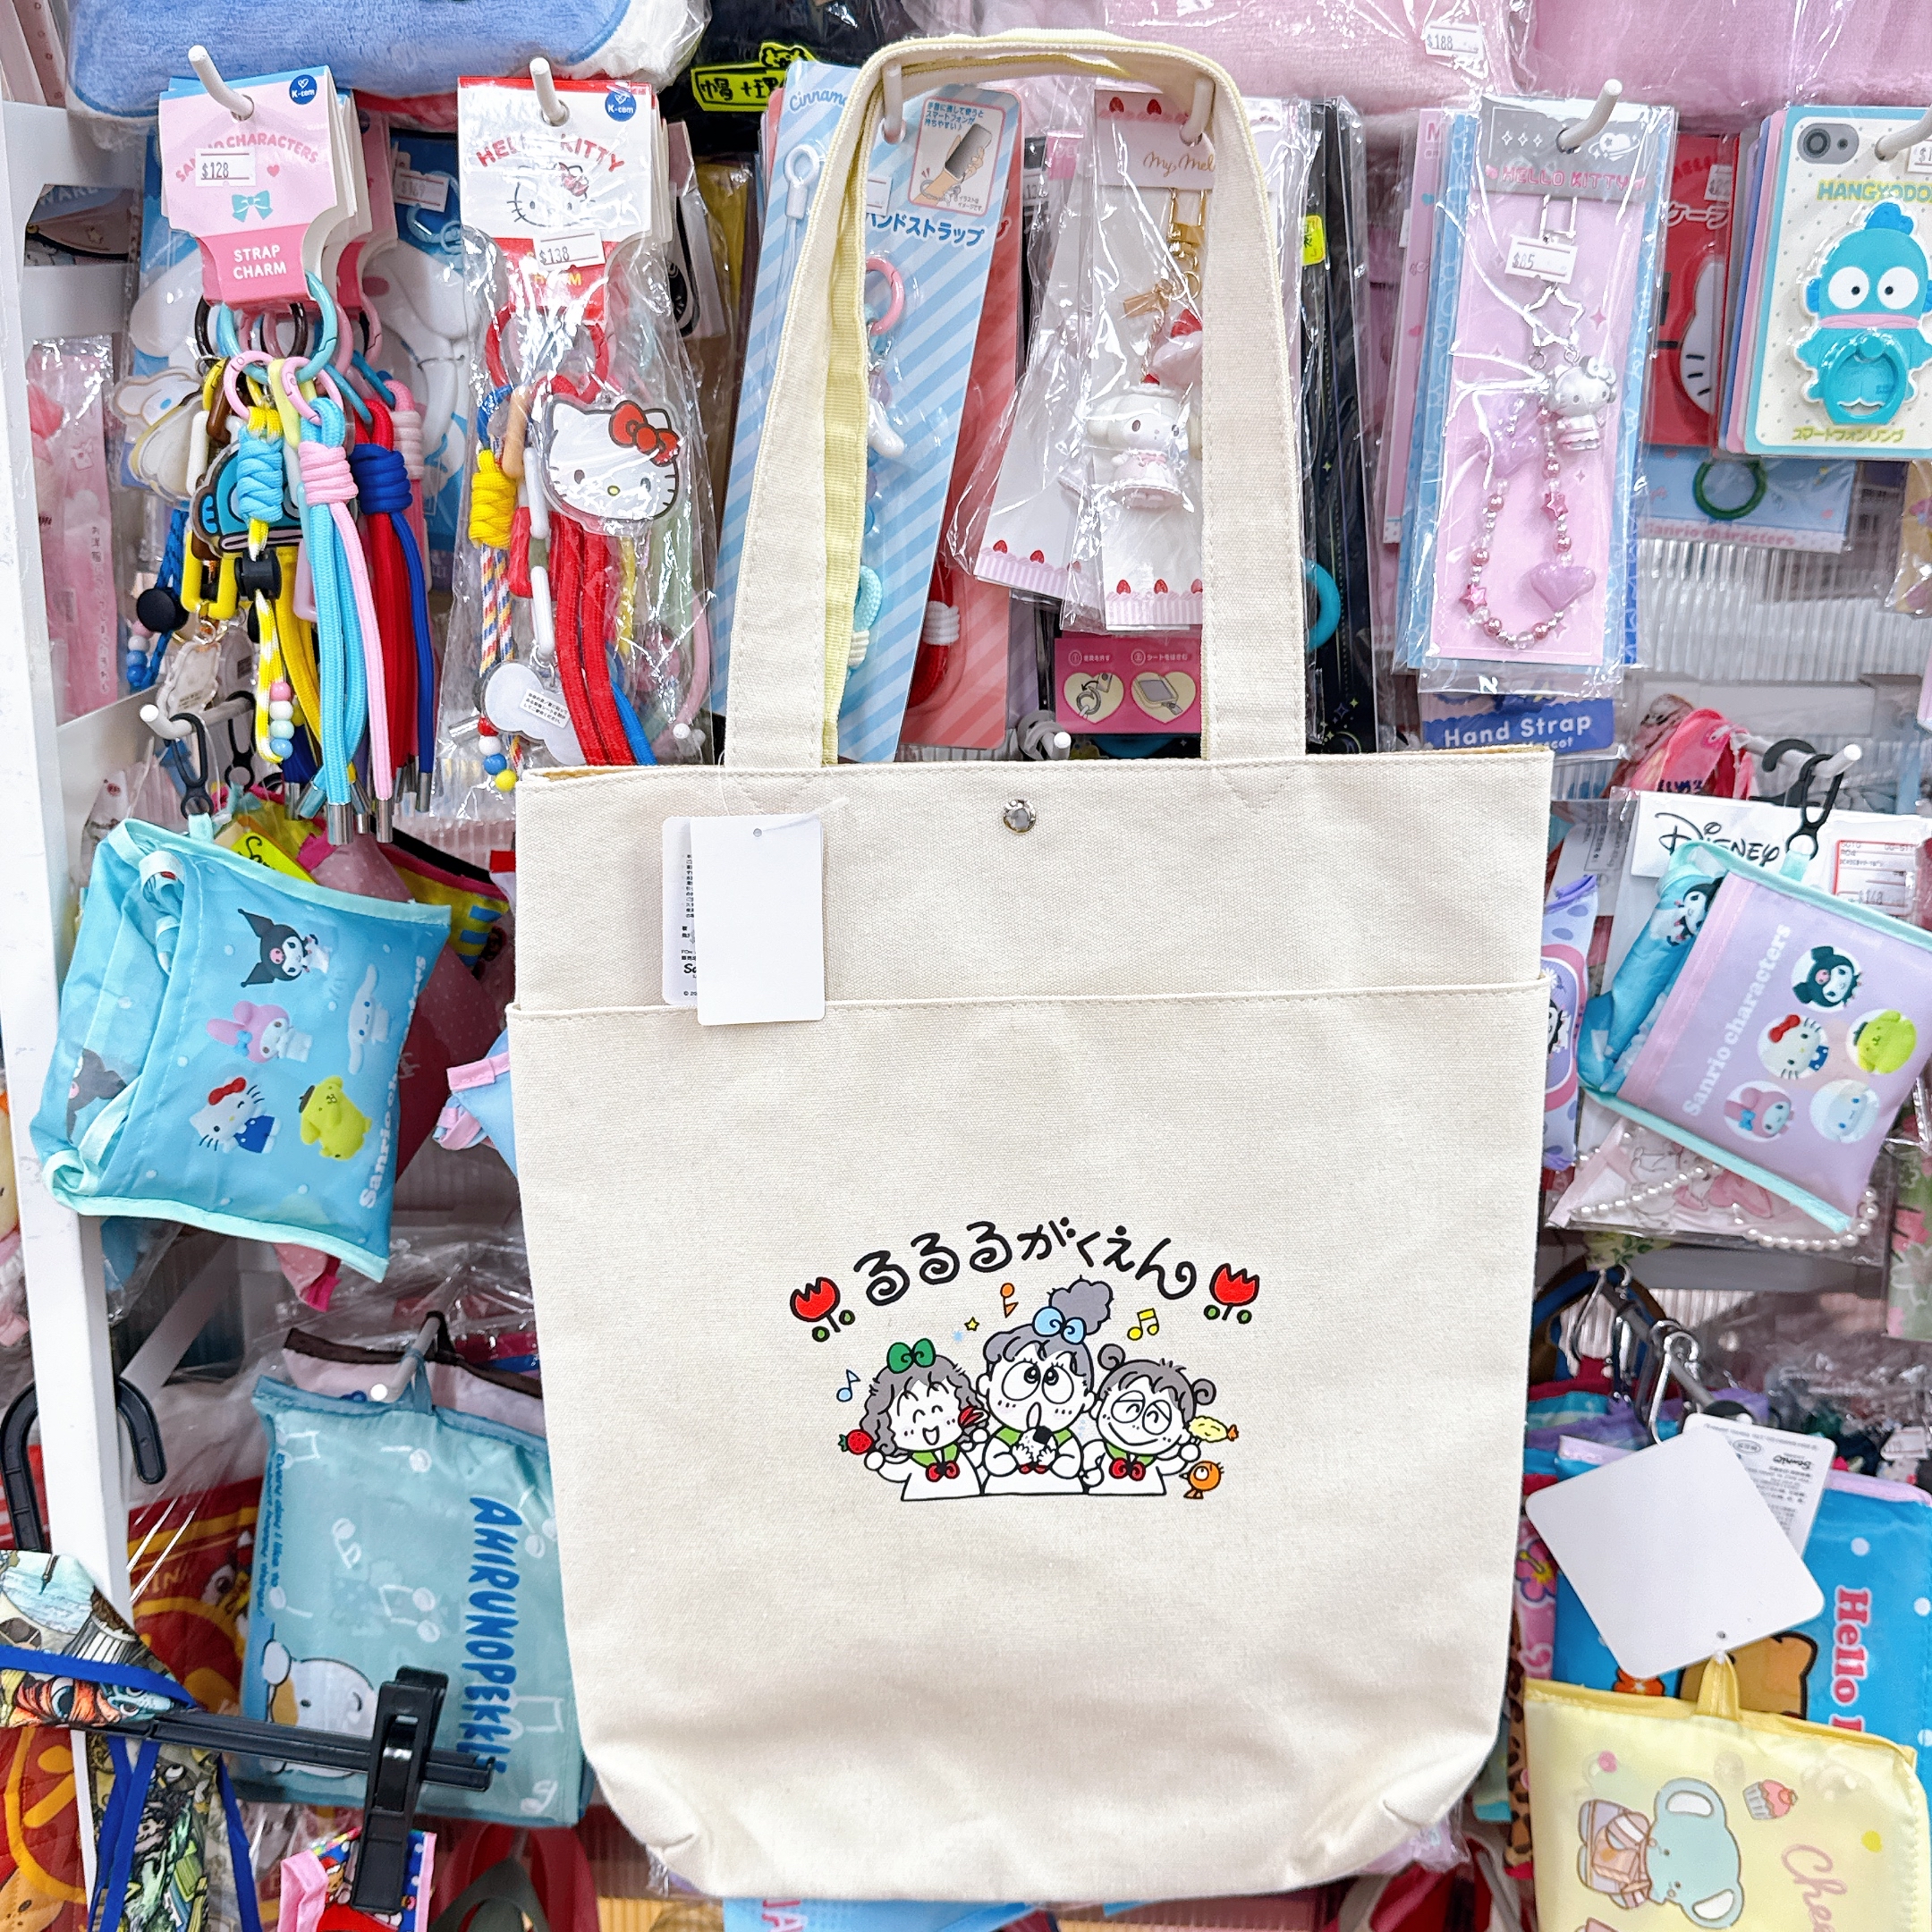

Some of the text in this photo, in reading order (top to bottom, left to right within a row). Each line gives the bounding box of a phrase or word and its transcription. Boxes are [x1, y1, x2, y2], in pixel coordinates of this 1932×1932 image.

[1427, 34, 1453, 50] $188
[225, 132, 318, 164] CHARACTERS
[201, 162, 229, 179] $128
[1502, 166, 1630, 190] HELLO KITTY
[1817, 181, 1932, 203] HANGYODO
[233, 244, 281, 263] STRAP
[538, 246, 570, 266] $138
[233, 261, 287, 280] CHARM
[1792, 425, 1905, 443] スマートフォンリング
[1444, 716, 1592, 748] Hand Strap
[1682, 923, 1791, 1117] Sanrio characters
[853, 1216, 1198, 1308] るるるがくえん
[1833, 1585, 1872, 1705] Hello
